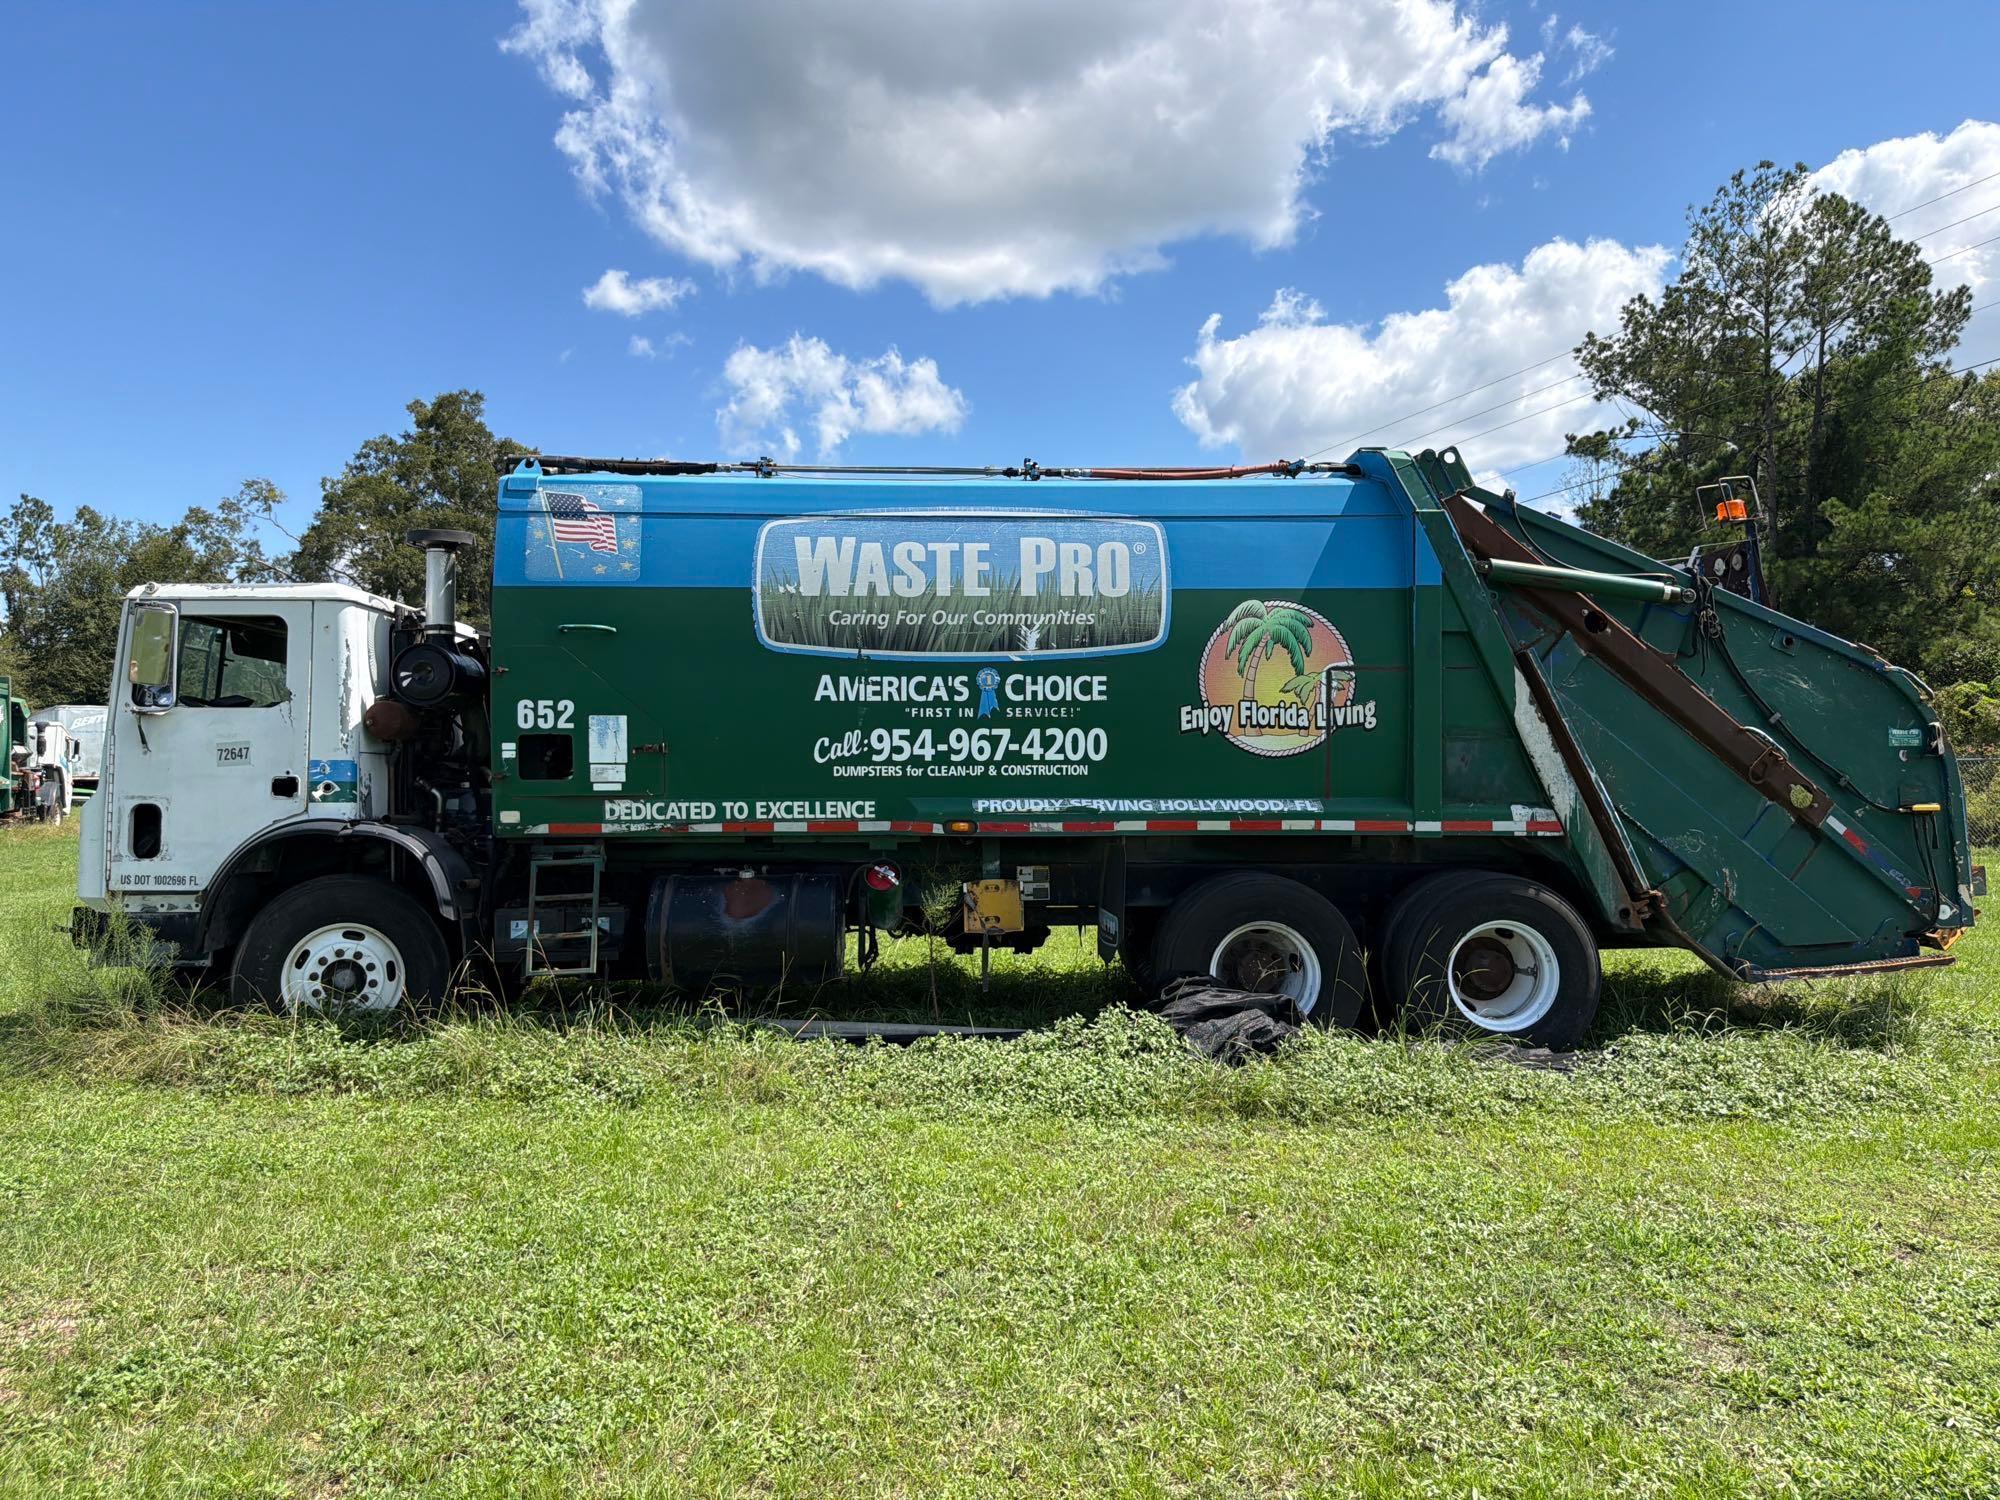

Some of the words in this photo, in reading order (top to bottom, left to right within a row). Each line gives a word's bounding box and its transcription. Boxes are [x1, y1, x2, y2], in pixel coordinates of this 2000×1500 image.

[794, 536, 990, 598] WASTE
[829, 609, 889, 630] Caring
[895, 609, 926, 625] For
[932, 609, 968, 625] Our
[814, 674, 970, 702] AMERICA'S
[1004, 674, 1108, 702] CHOICE
[517, 699, 575, 730] 652
[904, 707, 952, 718] "FIRST
[958, 707, 974, 718] IN
[1006, 707, 1081, 718] SERVICE!"
[1180, 702, 1234, 734] Enjoy
[1240, 700, 1310, 729] Florida
[217, 746, 250, 761] 72647
[813, 729, 869, 764] Call:
[869, 727, 1108, 762] 954-967-4200
[833, 765, 903, 777] DUMPSTERS
[905, 765, 924, 777] for
[926, 765, 985, 777] CLEAN-UP
[988, 765, 998, 777] &
[1000, 764, 1089, 777] CONSTRUCTION
[604, 801, 717, 821] DEDICATED
[721, 801, 750, 820] TO
[755, 800, 876, 820] EXCELLENCE
[977, 799, 1063, 813] PROUDLY
[1294, 799, 1319, 812] FL
[120, 874, 132, 885] US
[134, 874, 151, 885] DOT
[154, 875, 187, 886] 1002696
[189, 875, 199, 886] FL
